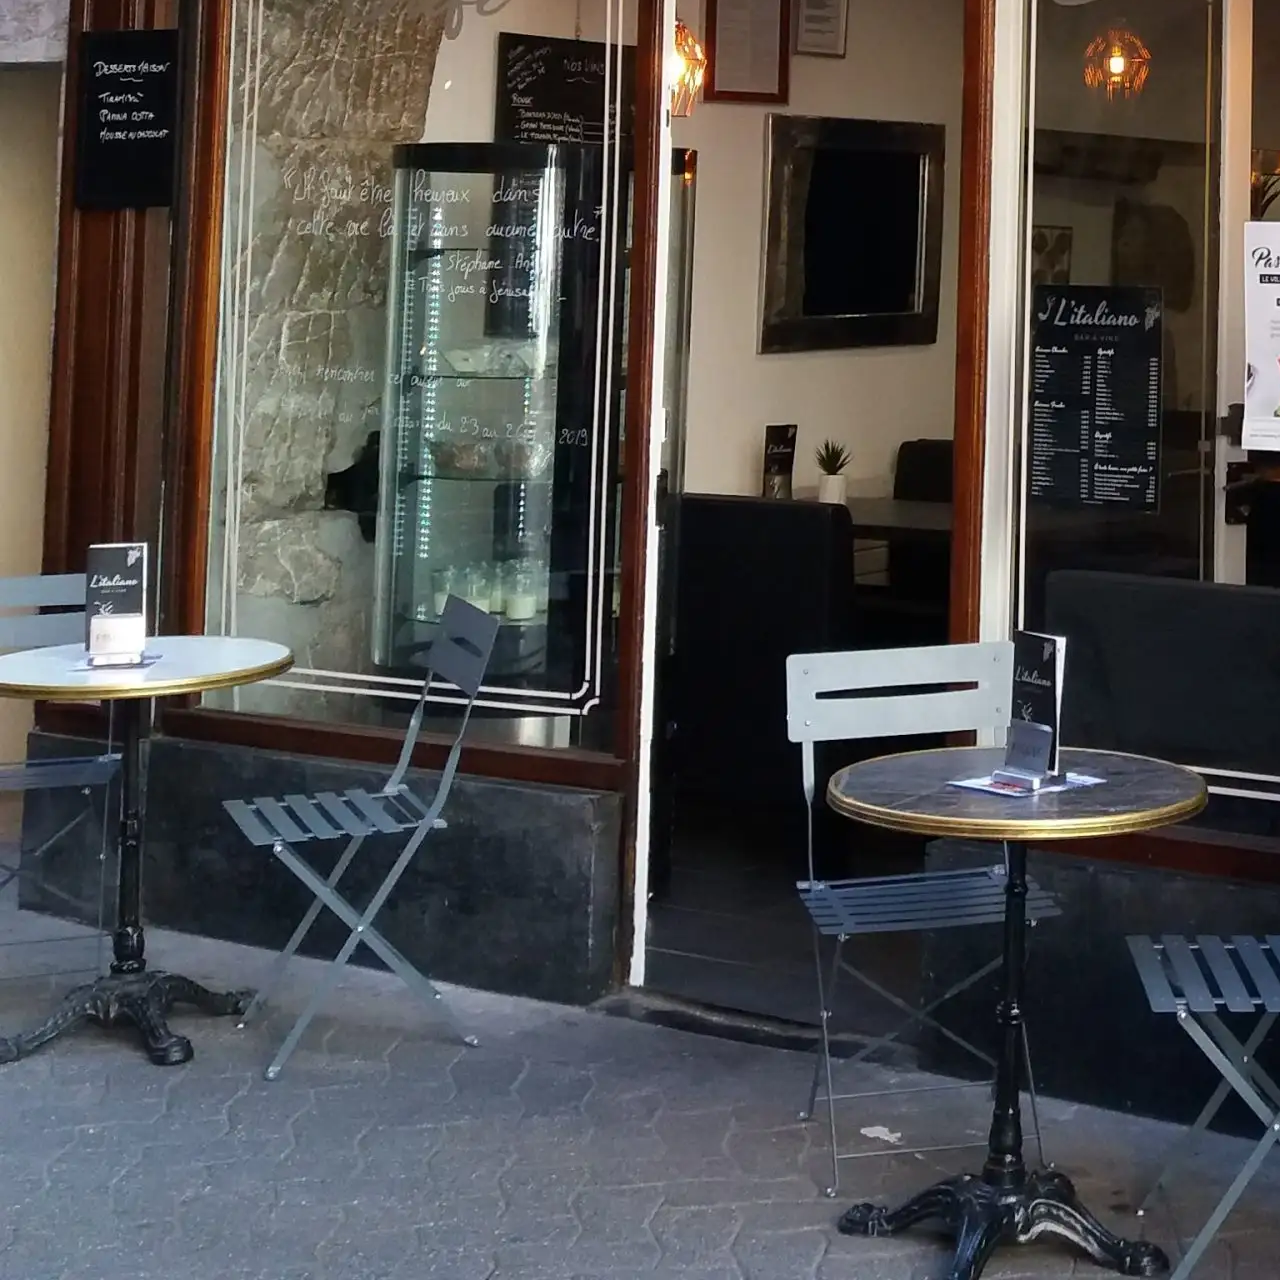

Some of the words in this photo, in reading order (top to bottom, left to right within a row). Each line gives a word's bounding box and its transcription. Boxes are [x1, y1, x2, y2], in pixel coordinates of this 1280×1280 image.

[100, 127, 128, 143] MOUSSE
[447, 249, 504, 280] Stéphane
[1053, 296, 1140, 327] L'italiano
[558, 427, 589, 447] 2019
[90, 574, 139, 588] L'italiano
